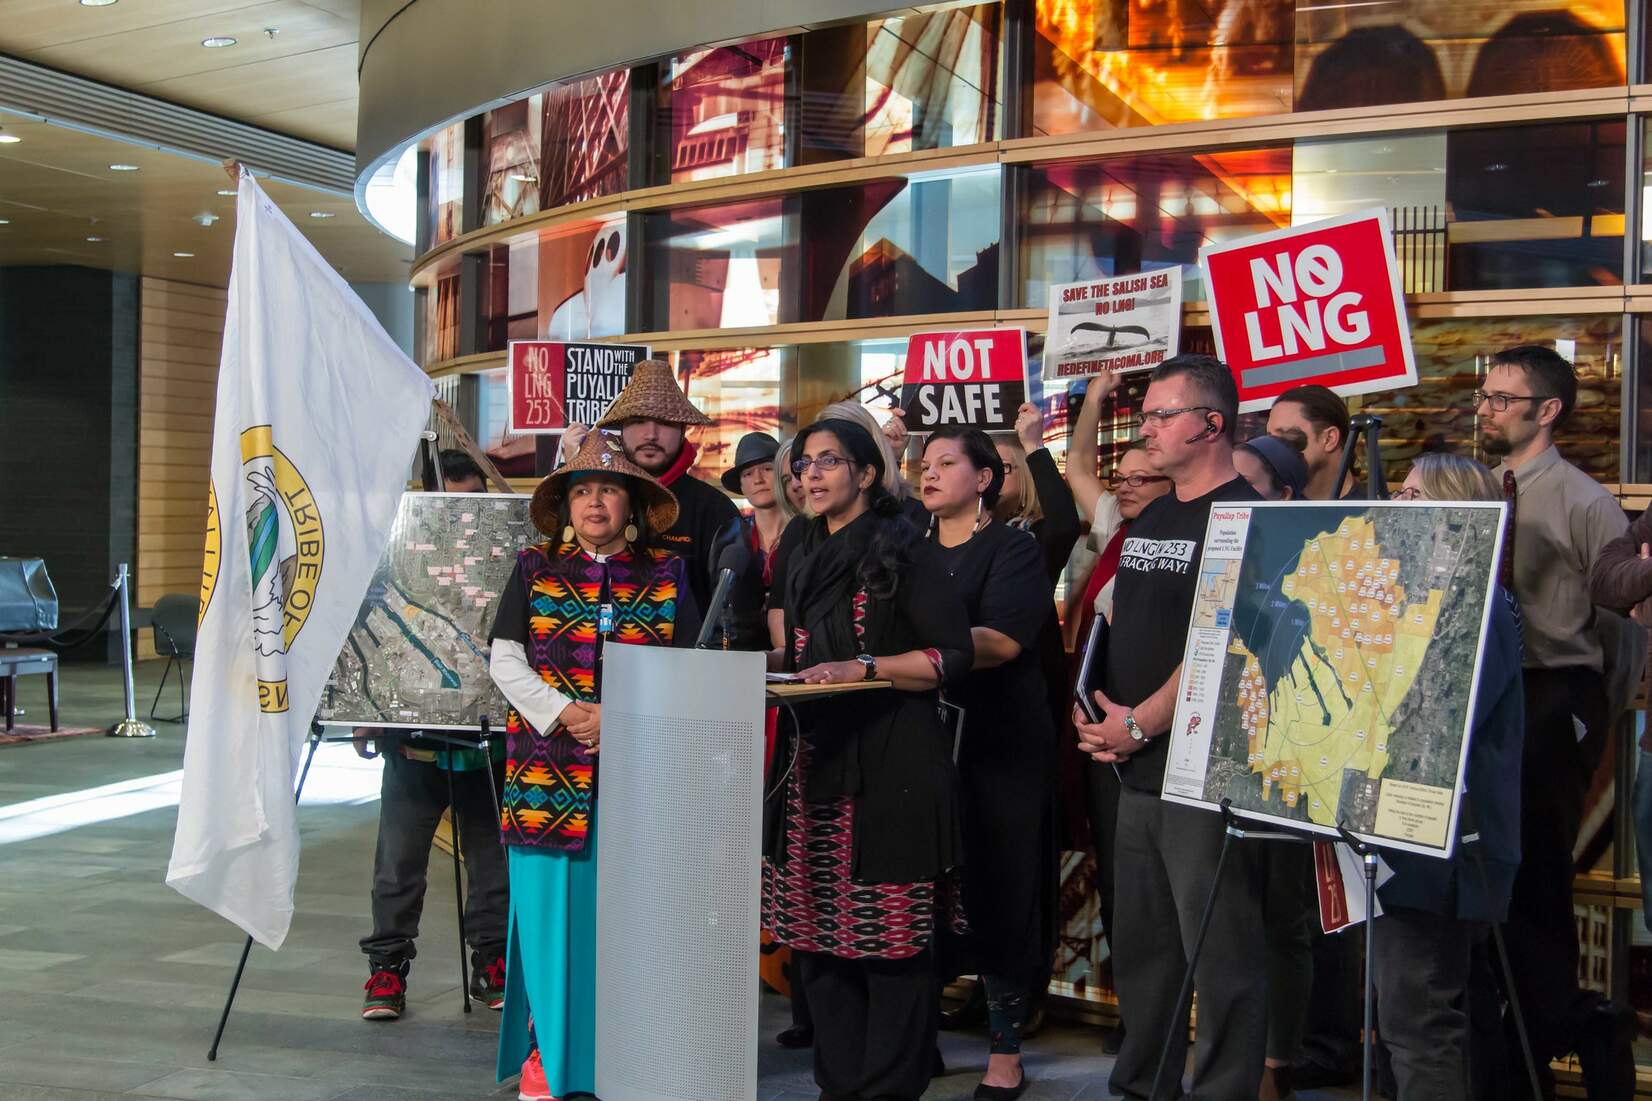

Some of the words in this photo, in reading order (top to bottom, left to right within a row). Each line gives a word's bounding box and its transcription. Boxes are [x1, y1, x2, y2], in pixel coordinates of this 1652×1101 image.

[1062, 286, 1088, 303] SAVE
[1091, 284, 1110, 299] THE
[1112, 278, 1147, 295] SALISH
[1150, 273, 1168, 290] SEA
[1249, 244, 1343, 309] NO
[1095, 300, 1110, 316] NO
[1112, 297, 1136, 315] LNG!
[1244, 291, 1371, 362] LNG
[527, 347, 549, 373] NO
[566, 347, 614, 375] STAND
[614, 350, 635, 363] WITH
[614, 363, 628, 376] THE
[923, 338, 994, 380] NOT
[524, 373, 552, 399] LNG
[526, 399, 551, 425] 253
[918, 383, 1004, 426] SAFE
[1133, 541, 1157, 556] LNG
[1164, 541, 1188, 556] 253
[1157, 558, 1189, 574] WAY!
